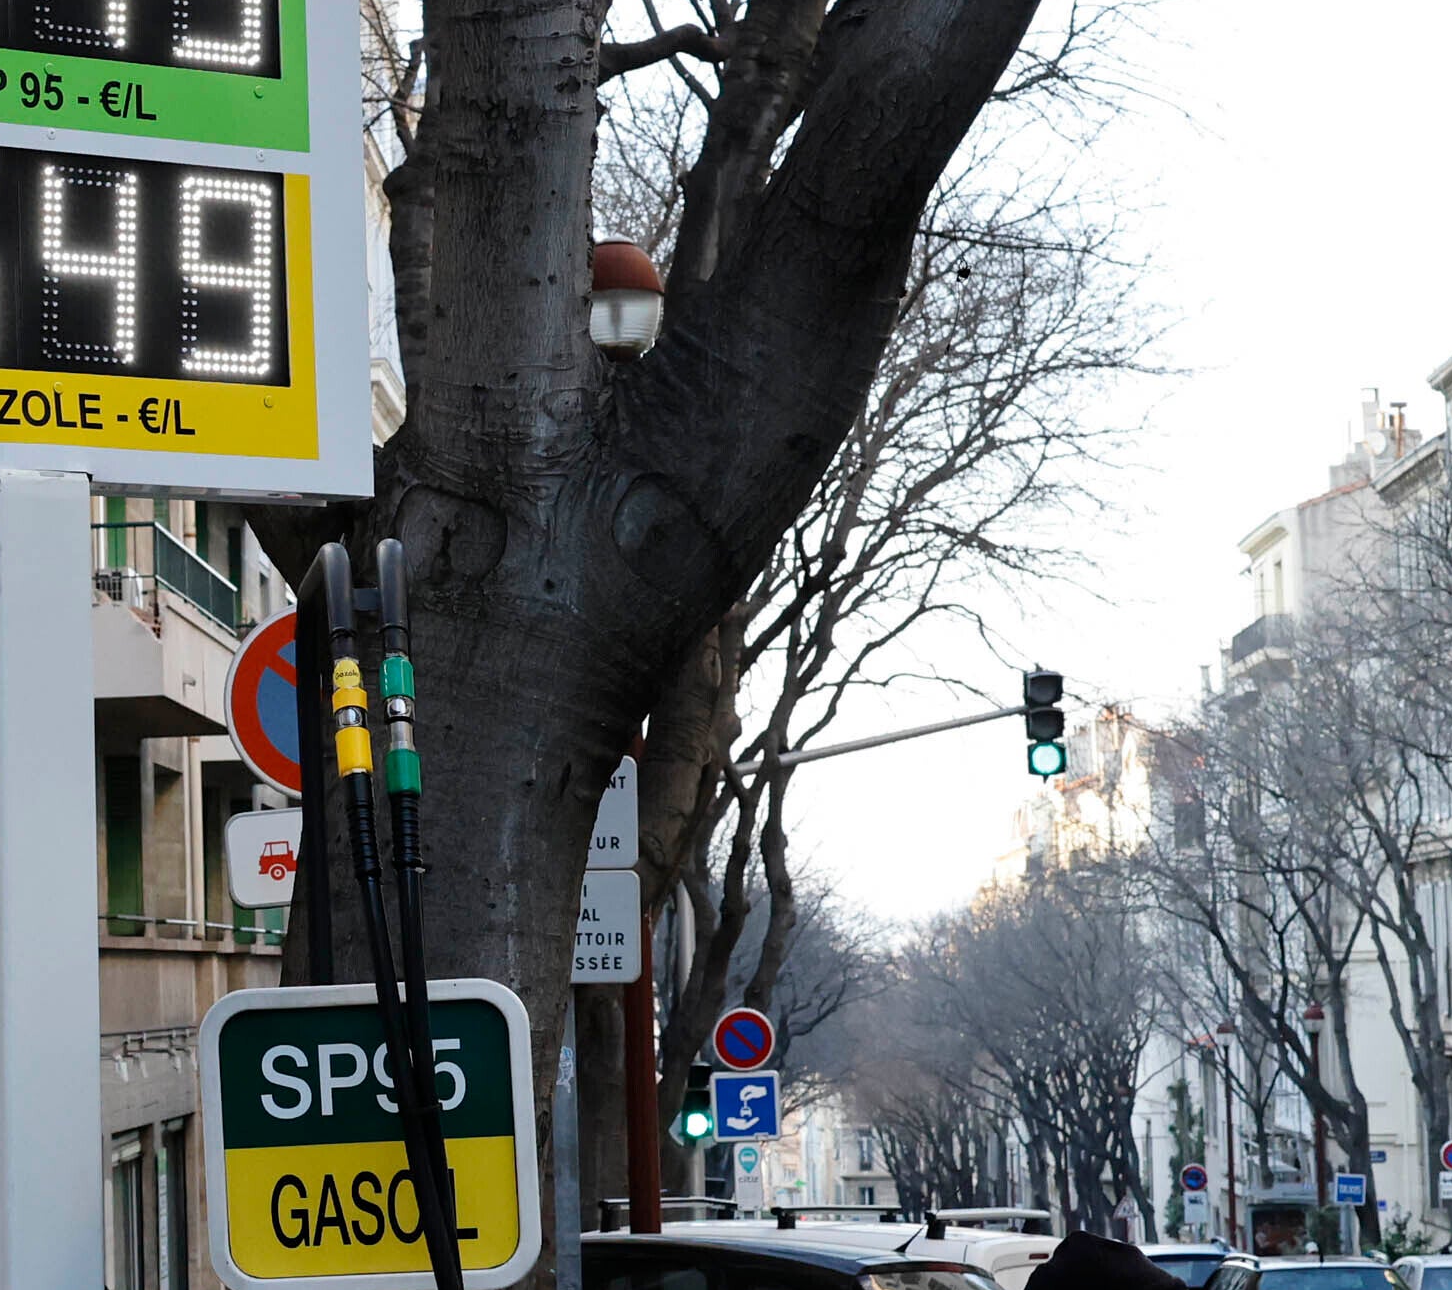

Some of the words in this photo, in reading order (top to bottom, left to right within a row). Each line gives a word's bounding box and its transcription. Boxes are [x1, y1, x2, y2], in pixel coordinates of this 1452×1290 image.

[20, 72, 64, 111] 95
[99, 81, 157, 121] €/L
[138, 397, 196, 435] €/L
[589, 836, 620, 850] UR
[270, 1168, 478, 1249] GASOL
